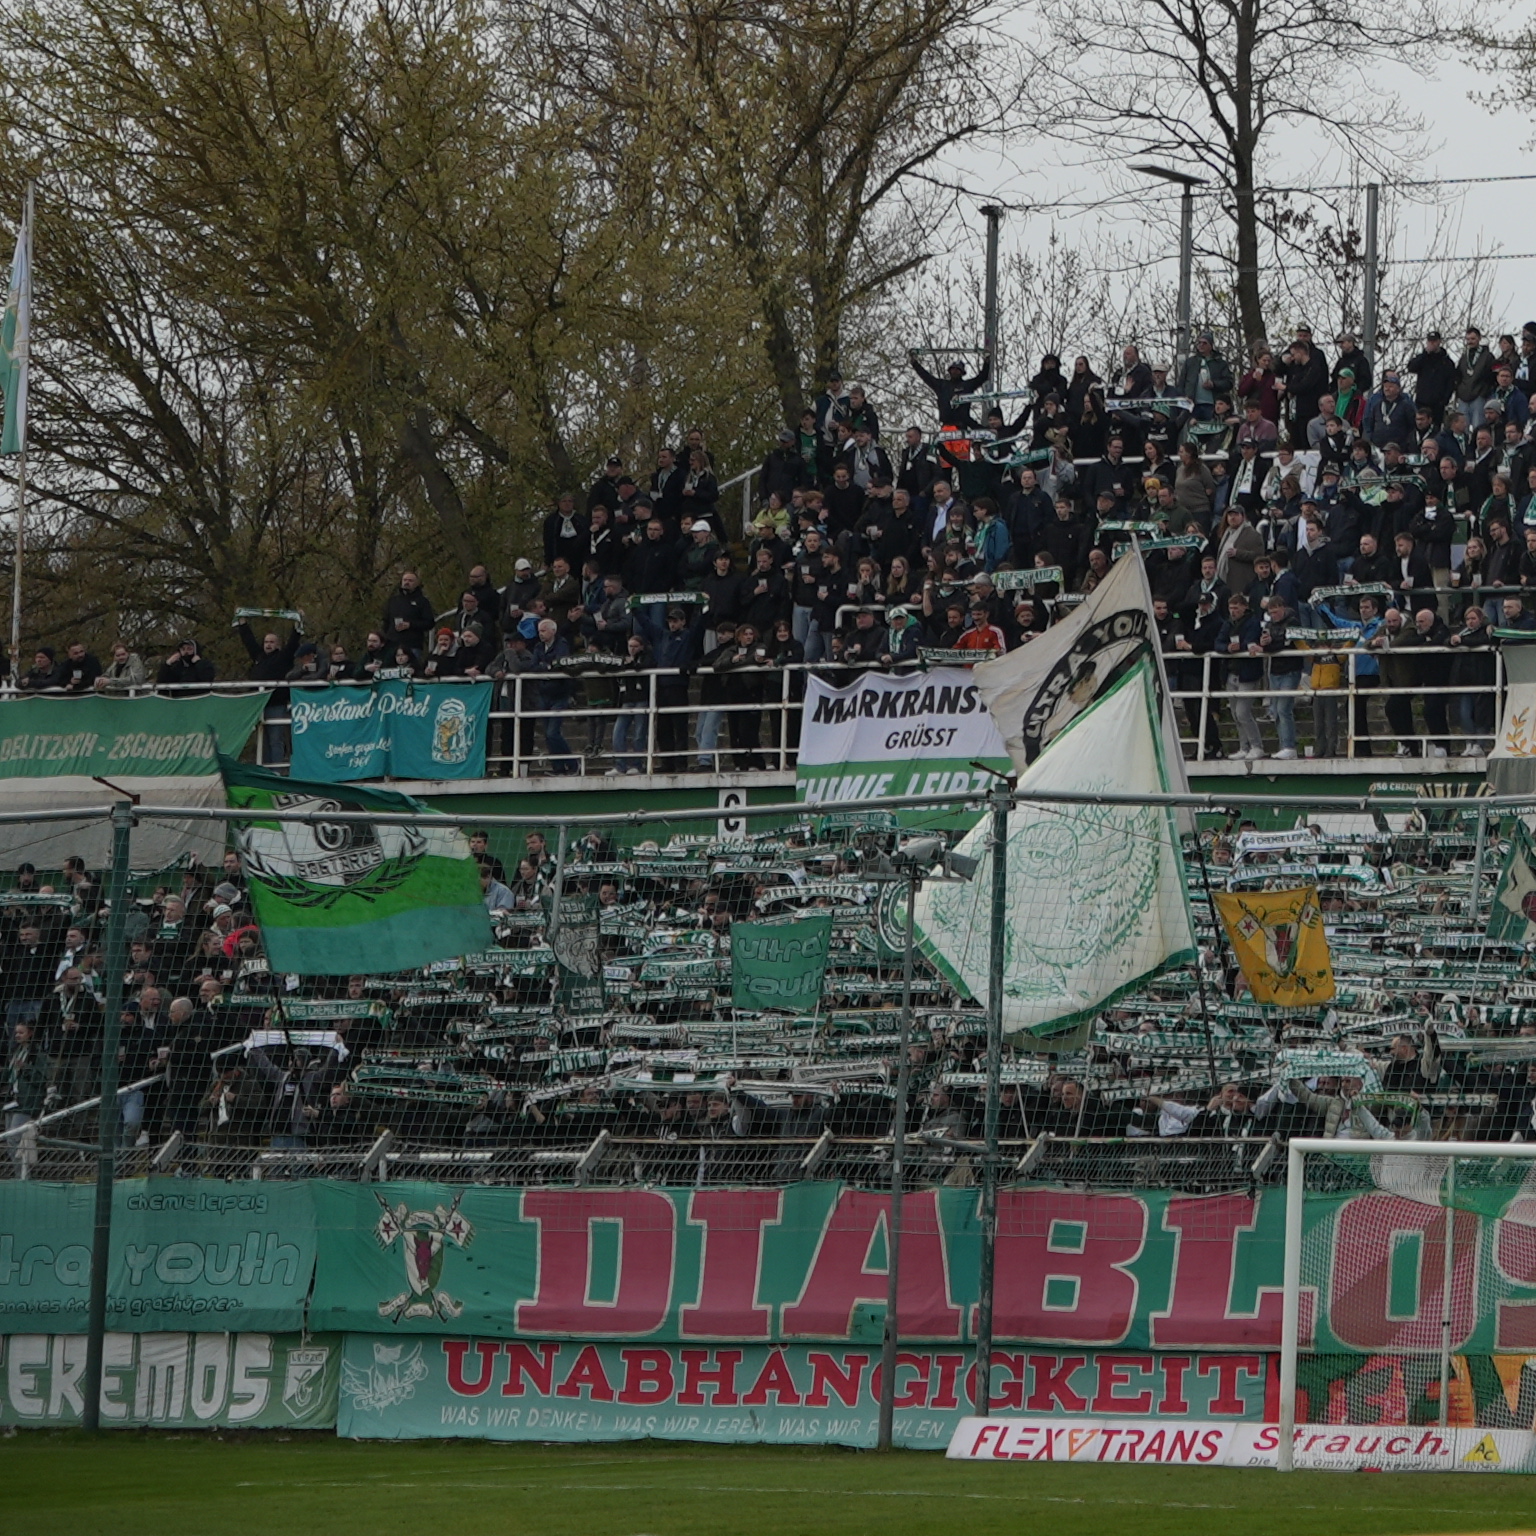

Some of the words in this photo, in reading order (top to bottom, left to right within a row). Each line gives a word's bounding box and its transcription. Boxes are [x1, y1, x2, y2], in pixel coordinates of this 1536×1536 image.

[291, 690, 378, 735] Bierstand
[811, 685, 987, 726] MARKRANS
[1, 733, 99, 763] DELITZSCH
[106, 731, 218, 761] ZSCHORTAU
[885, 726, 958, 751] GRÜSST
[722, 792, 742, 832] C
[125, 1230, 301, 1286] youth
[440, 1340, 1260, 1416] UNABHÄNGIGKEIT
[440, 1405, 479, 1426] WAS
[485, 1406, 520, 1427] WIR
[614, 1413, 656, 1435] WAS
[662, 1415, 700, 1437] WIR
[777, 1417, 818, 1440] WAS
[823, 1419, 862, 1441] WIR
[866, 1420, 946, 1441] FHLEN
